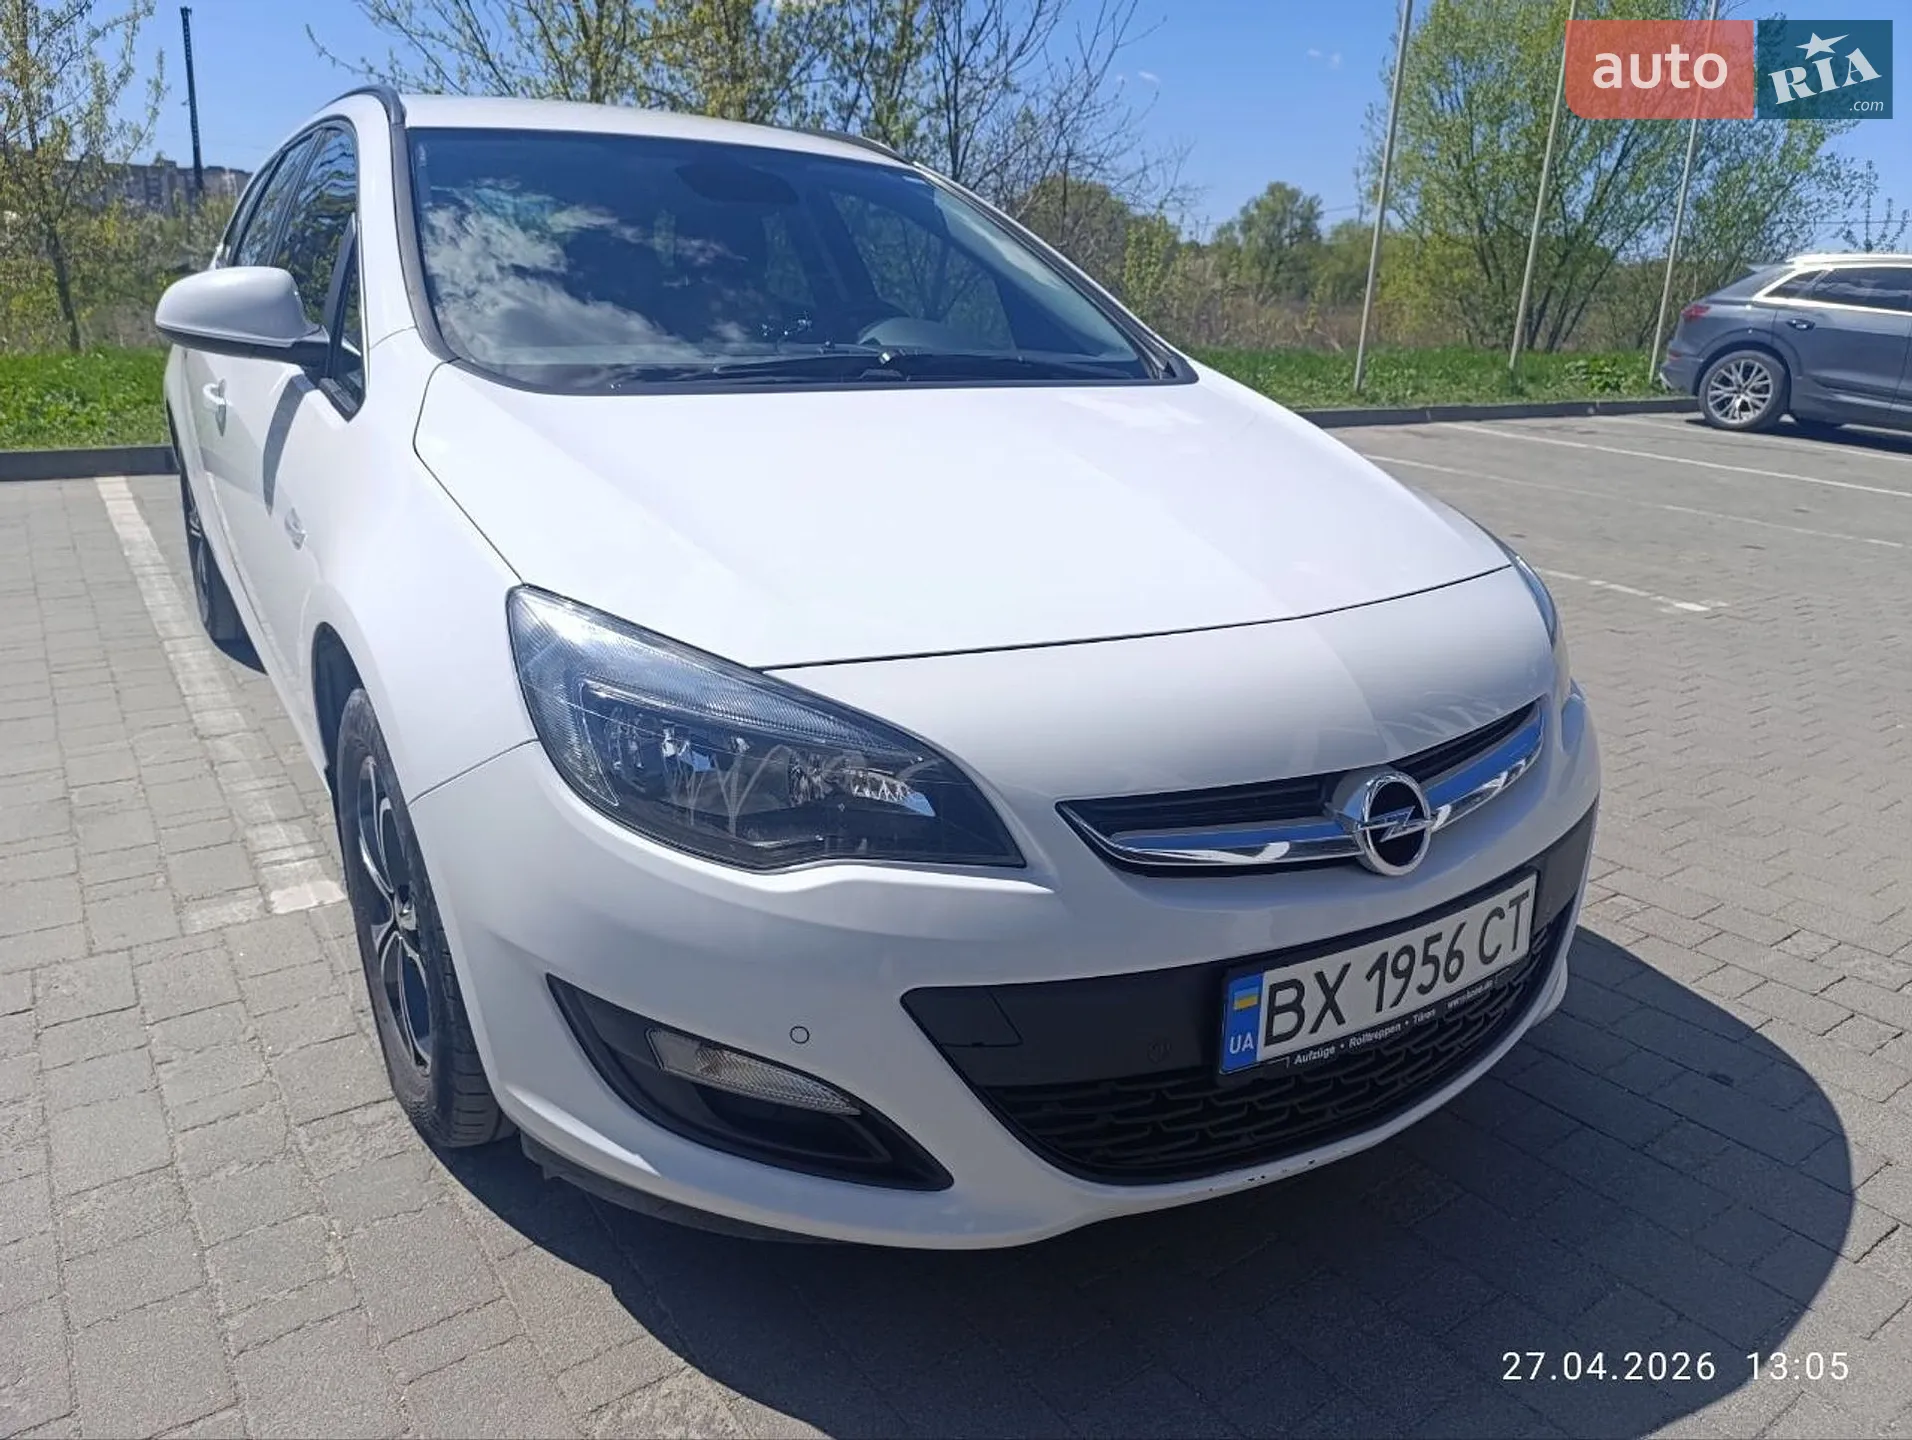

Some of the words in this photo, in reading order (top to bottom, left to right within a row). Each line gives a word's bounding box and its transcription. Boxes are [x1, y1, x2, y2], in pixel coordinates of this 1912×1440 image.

[1263, 962, 1351, 1047] BX
[1365, 921, 1466, 1014] 1956
[1478, 890, 1530, 966] CT
[1229, 1027, 1254, 1055] UA
